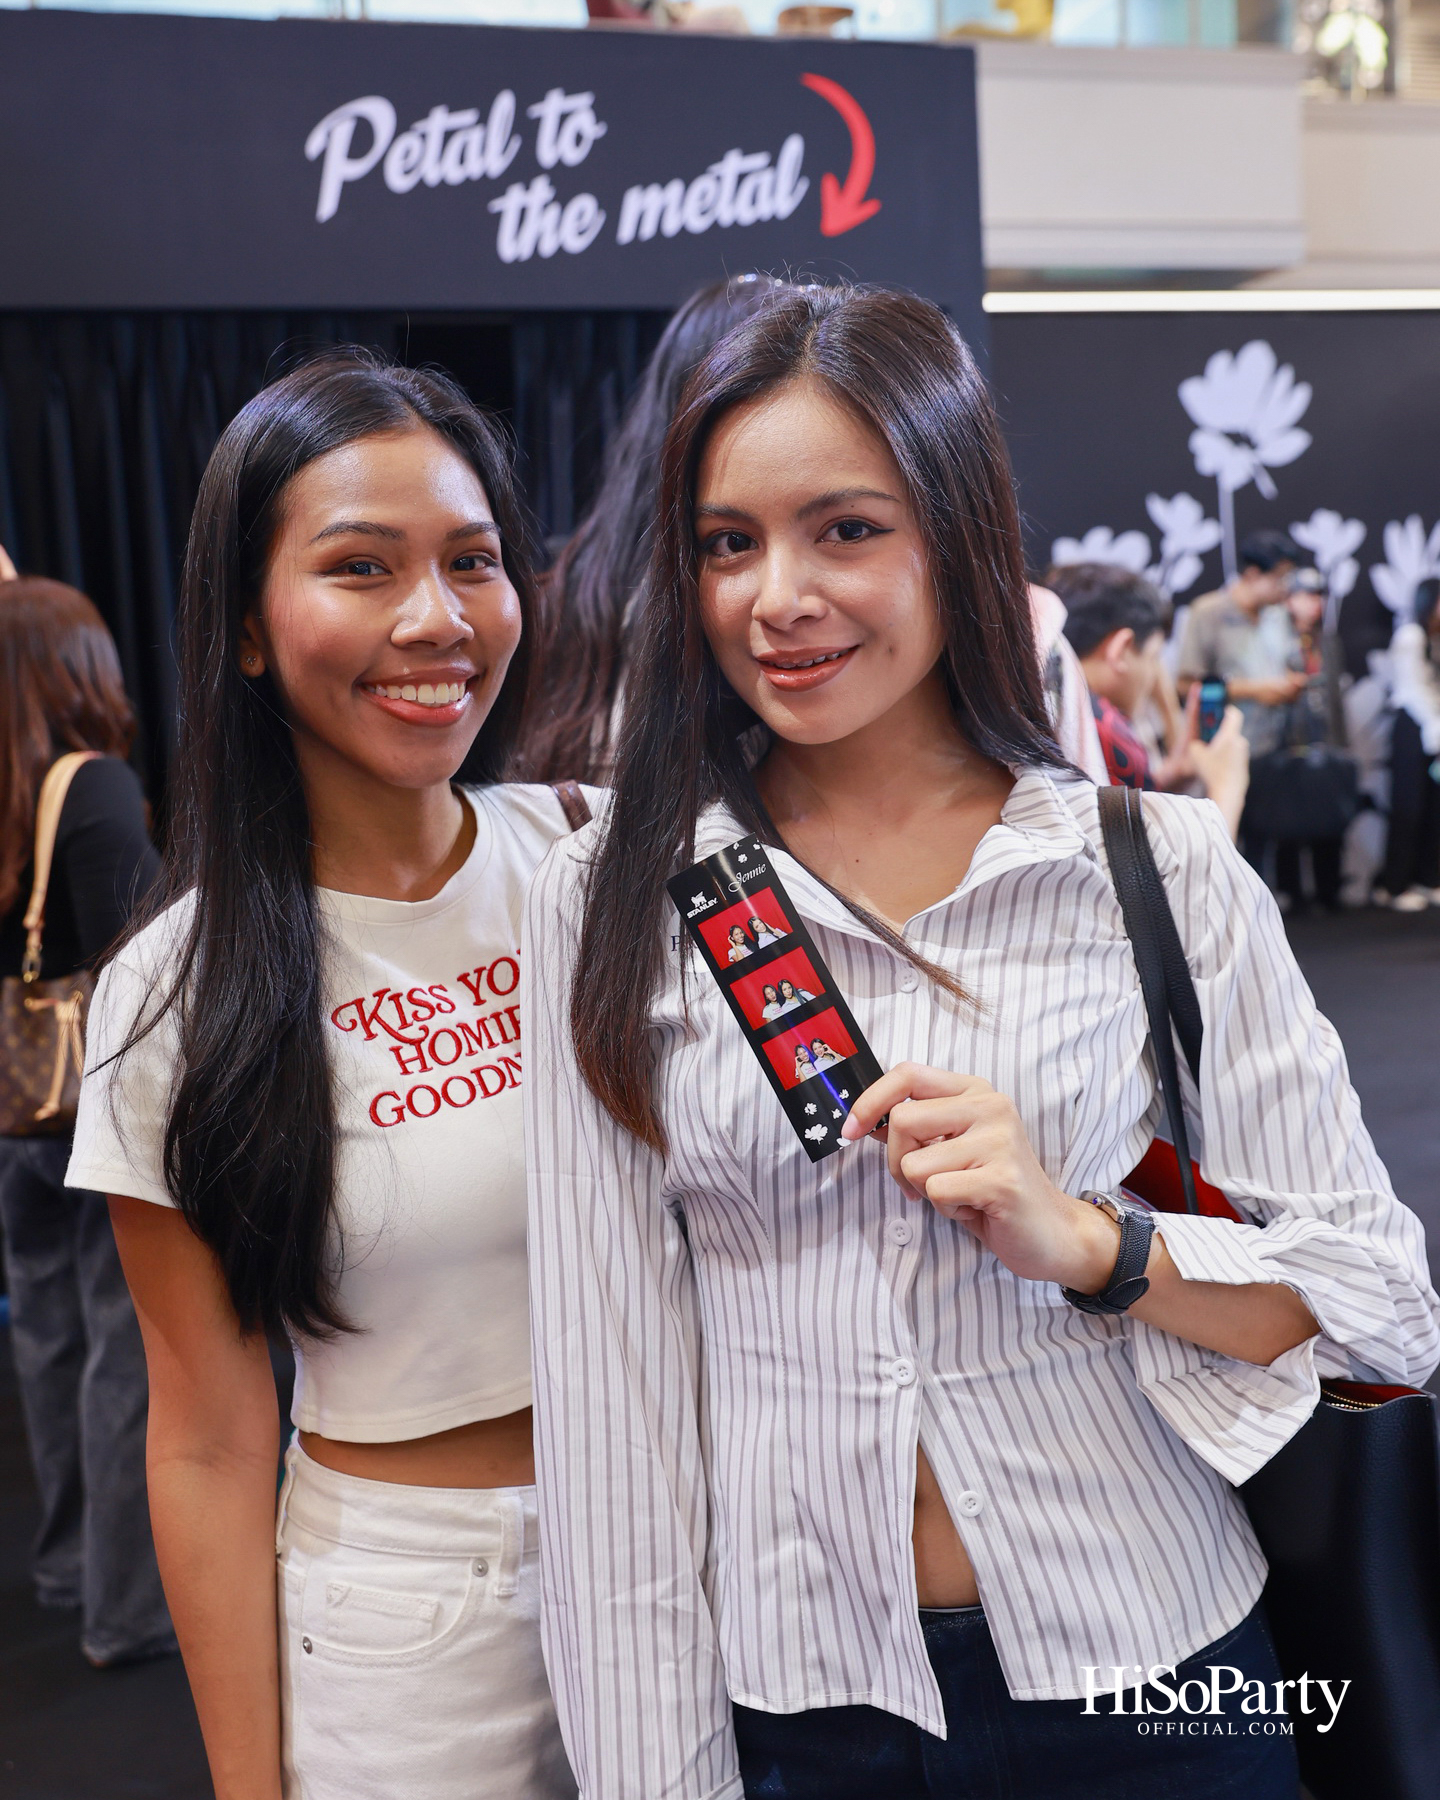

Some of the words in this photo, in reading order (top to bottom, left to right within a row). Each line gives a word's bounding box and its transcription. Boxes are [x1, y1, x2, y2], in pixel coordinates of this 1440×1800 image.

[305, 89, 521, 222] Petal
[528, 88, 607, 168] to
[489, 174, 606, 263] the
[616, 134, 809, 245] metal
[686, 897, 718, 919] STANLEY
[728, 863, 767, 892] Jennie
[331, 984, 456, 1044] KISS
[457, 949, 520, 1006] YO
